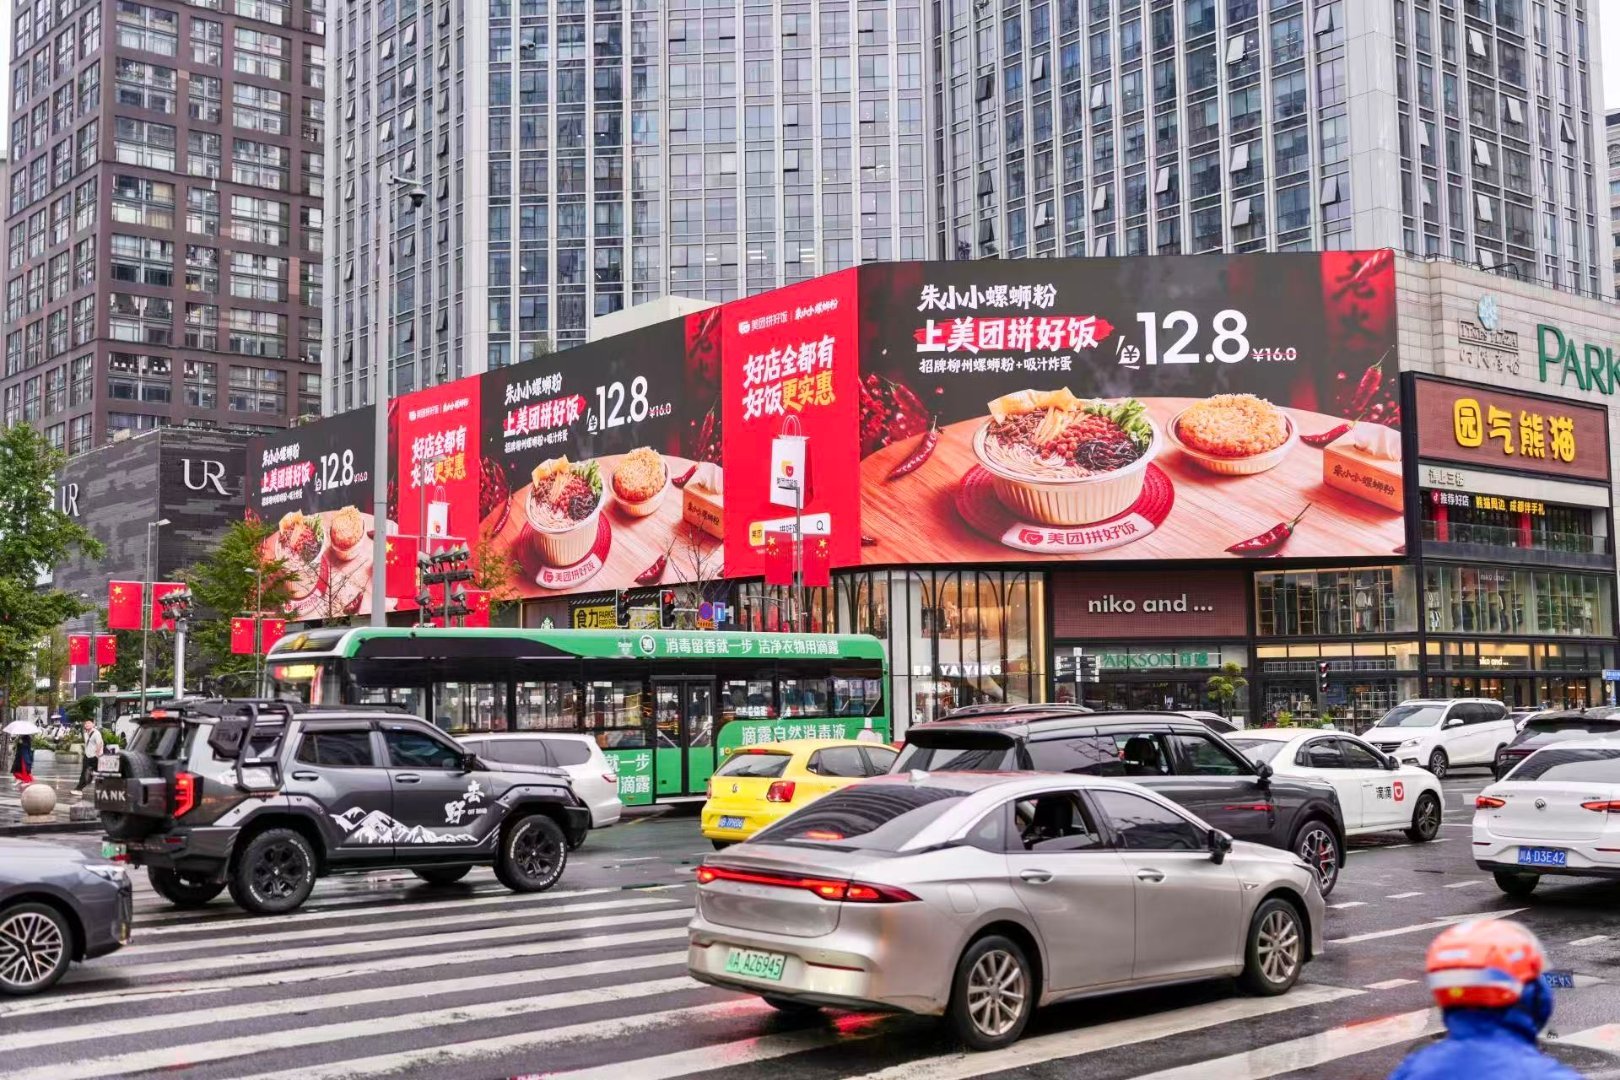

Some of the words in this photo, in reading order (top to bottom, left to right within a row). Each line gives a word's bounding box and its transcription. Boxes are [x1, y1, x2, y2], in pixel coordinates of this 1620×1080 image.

[917, 284, 1057, 312] 朱小小螺蛳粉
[916, 315, 1099, 354] 上美团拼好饭
[742, 334, 835, 389] 好店全都有
[919, 355, 1073, 374] 招牌柳州螺蛳粉+吸汁炸蛋
[504, 372, 562, 406] 朱小小螺蛳粉
[742, 370, 836, 421] 好饭更实惠
[503, 394, 580, 438] 上美团拼好饭
[181, 458, 232, 496] UR
[61, 482, 80, 517] UR
[1047, 520, 1139, 545] 美团拼好饭
[1088, 594, 1136, 613] niko
[1142, 593, 1187, 613] and
[665, 637, 753, 655] 消毒留香就一步
[758, 638, 839, 655] 洁净衣物用滴露
[742, 724, 846, 745] 滴露自然消毒液
[96, 789, 126, 802] TANK
[617, 775, 650, 794] 滴露
